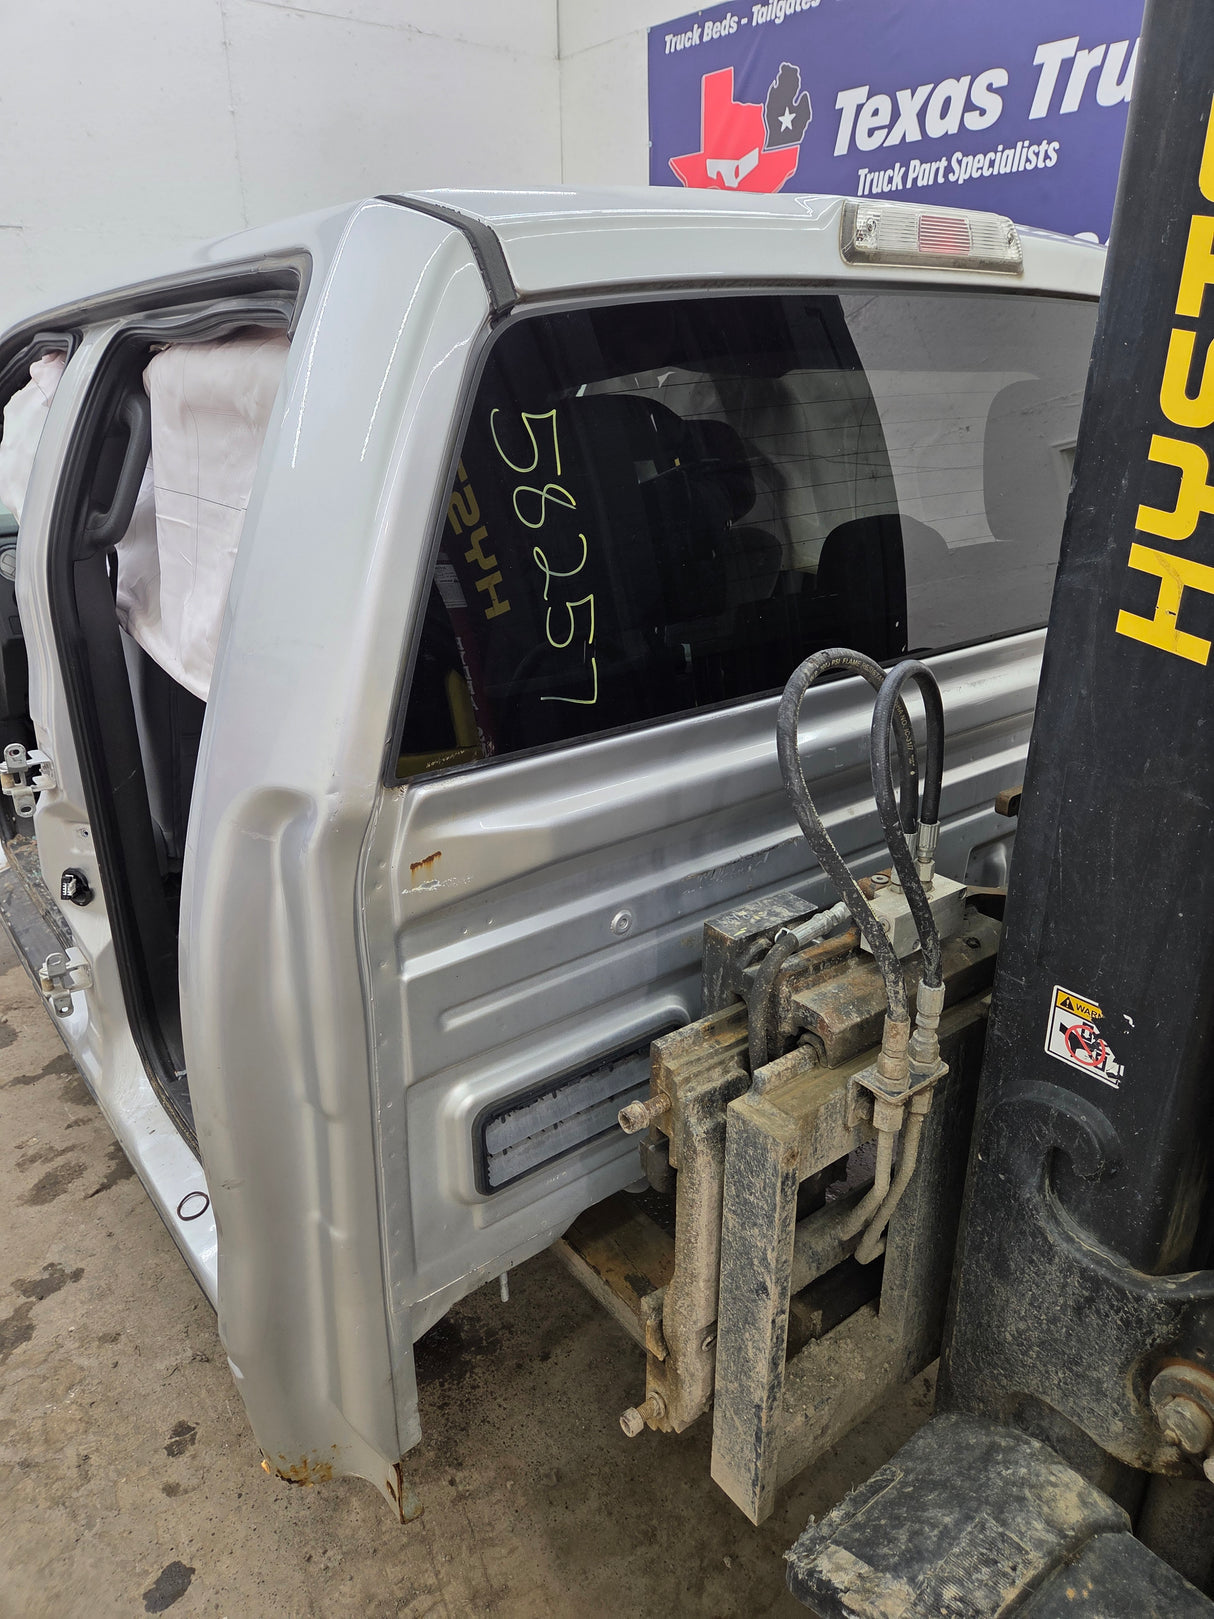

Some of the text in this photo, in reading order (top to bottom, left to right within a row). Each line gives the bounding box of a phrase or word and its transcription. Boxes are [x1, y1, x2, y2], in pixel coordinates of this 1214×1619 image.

[665, 24, 701, 54] Truck
[703, 13, 738, 43] Beds
[833, 36, 1140, 157] Texas Tru
[857, 139, 1060, 196] Truck Part Specialists
[489, 407, 599, 705] 58257
[842, 657, 861, 667] FLAME
